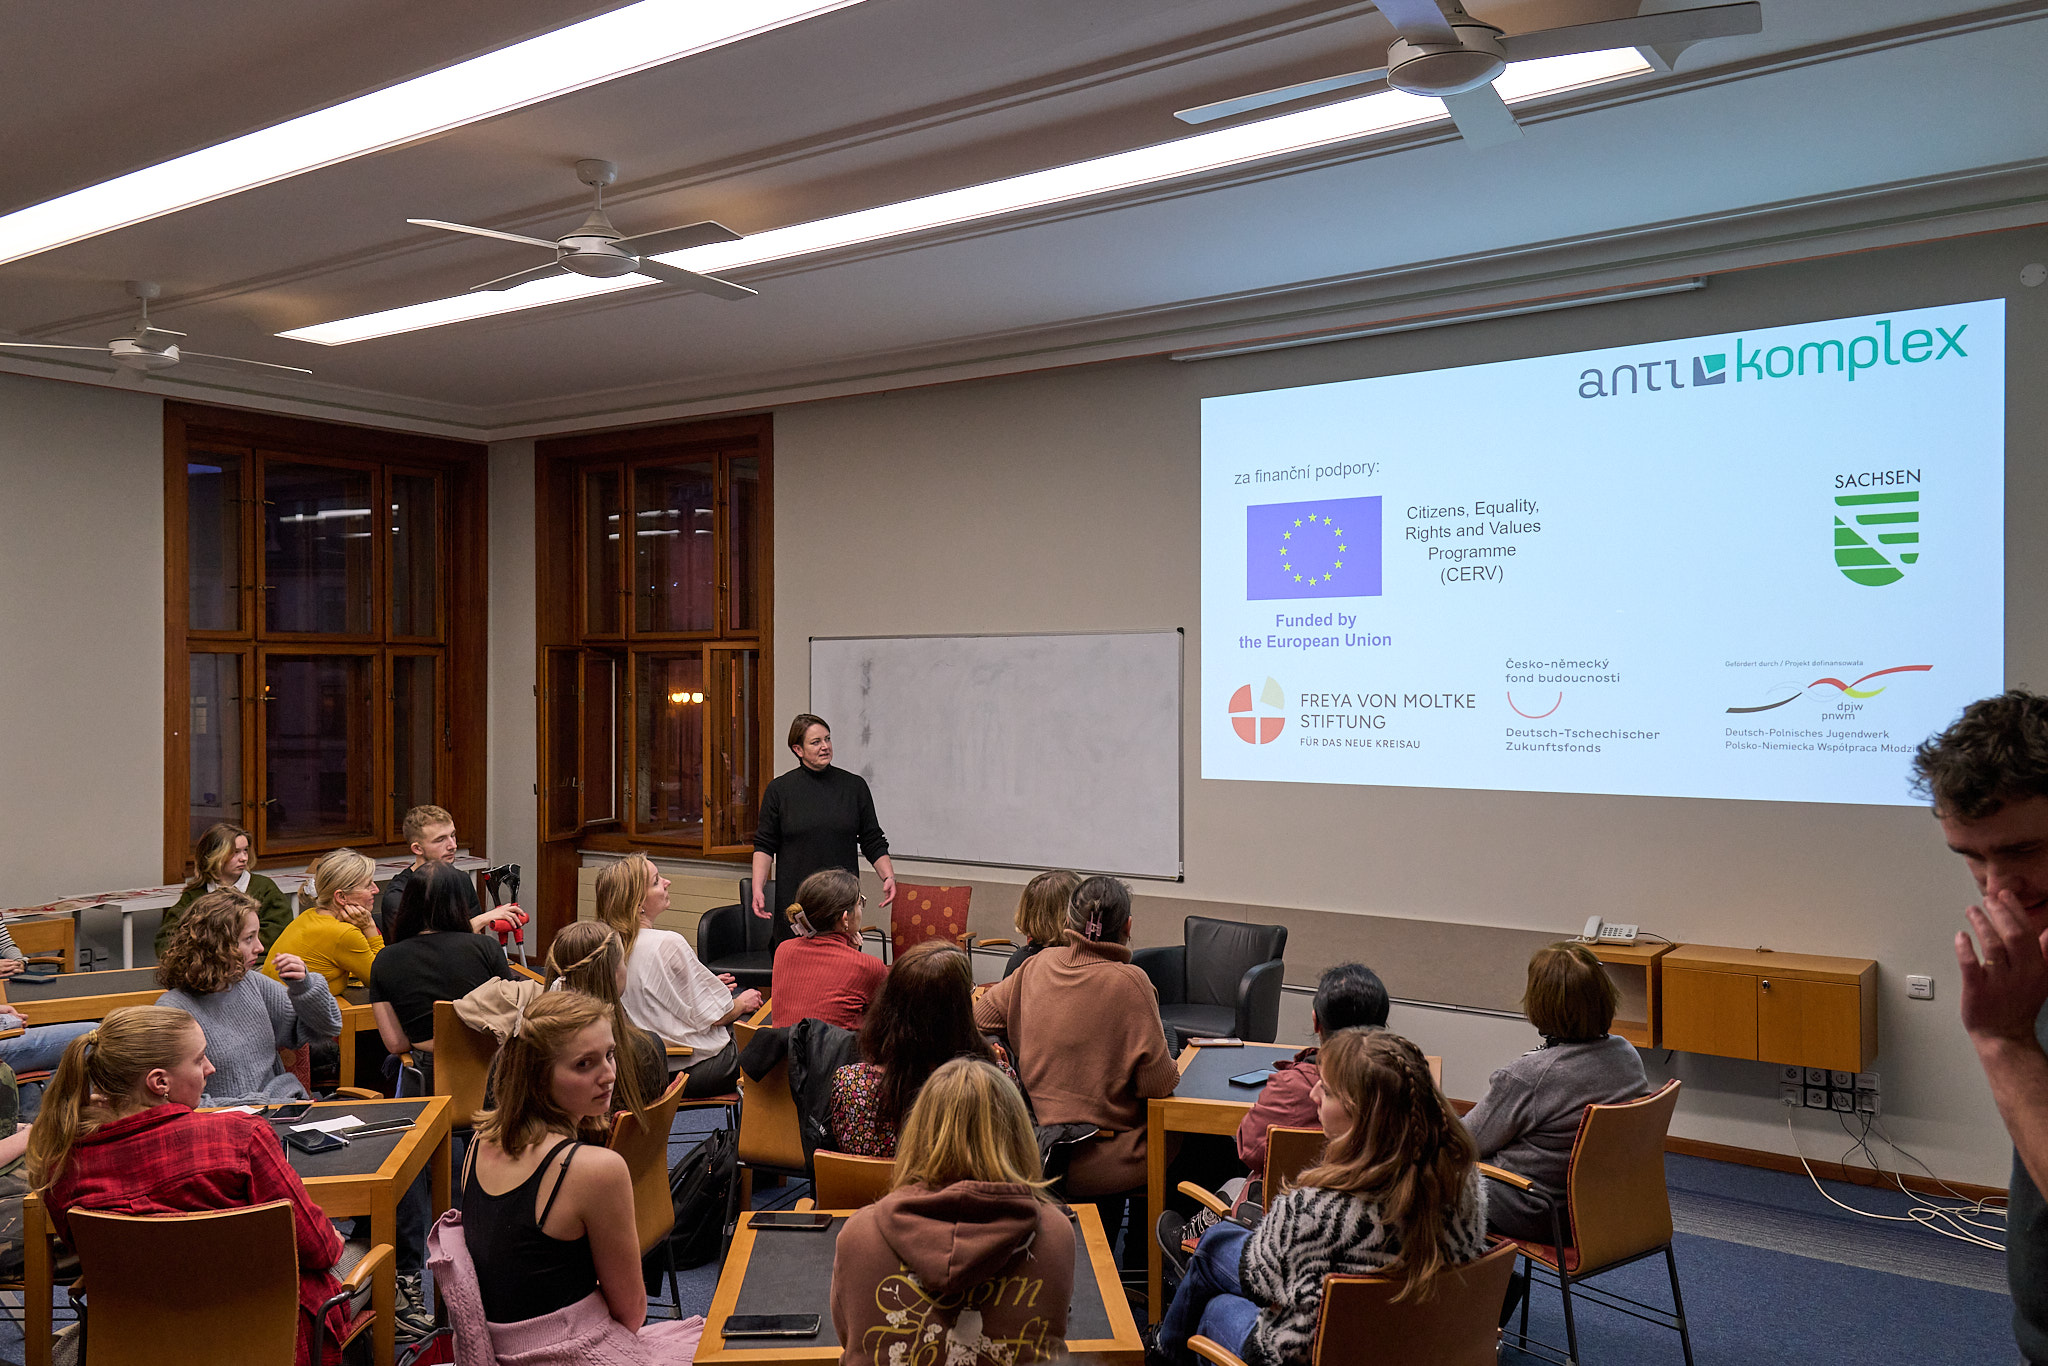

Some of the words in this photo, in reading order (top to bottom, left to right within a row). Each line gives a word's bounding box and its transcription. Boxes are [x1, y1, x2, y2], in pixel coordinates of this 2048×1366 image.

[1736, 319, 1968, 382] komplex
[1234, 472, 1251, 485] za
[1255, 468, 1311, 484] finanční
[1315, 460, 1380, 481] podpory:
[1834, 468, 1921, 489] SACHSEN
[1407, 504, 1470, 521] Citizens,
[1475, 498, 1540, 517] Equality,
[1405, 525, 1451, 543] Rights
[1456, 523, 1484, 538] and
[1489, 520, 1541, 535] Values
[1428, 545, 1517, 563] Programme
[1440, 565, 1504, 586] (CERV)
[1276, 613, 1333, 628] Funded
[1338, 612, 1357, 629] by
[1239, 635, 1262, 649] the
[1267, 634, 1339, 651] European
[1345, 632, 1392, 648] Union
[1505, 657, 1609, 670] Česko-německý
[1785, 660, 1810, 669] Projekt
[1505, 673, 1534, 683] fond
[1539, 672, 1620, 683] budoucnosti
[1301, 693, 1352, 708] FREYA
[1357, 693, 1397, 708] VON
[1404, 693, 1476, 709] MOLTKE
[1837, 702, 1864, 712] dpjw
[1300, 714, 1386, 730] STIFTUNG
[1821, 712, 1856, 722] pnwm
[1506, 728, 1660, 739] Deutsch-Tschechischer
[1725, 727, 1824, 738] Deutsch-Polnisches
[1826, 729, 1890, 740] Jugendwerk
[1300, 736, 1319, 747] FÜR
[1322, 738, 1342, 748] DAS
[1345, 738, 1372, 748] NEUE
[1375, 739, 1421, 749] KREISAU
[1505, 741, 1602, 752] Zukunftsfonds
[1725, 741, 1815, 751] Polsko-Niemiecka
[1880, 743, 1919, 753] Młodzi
